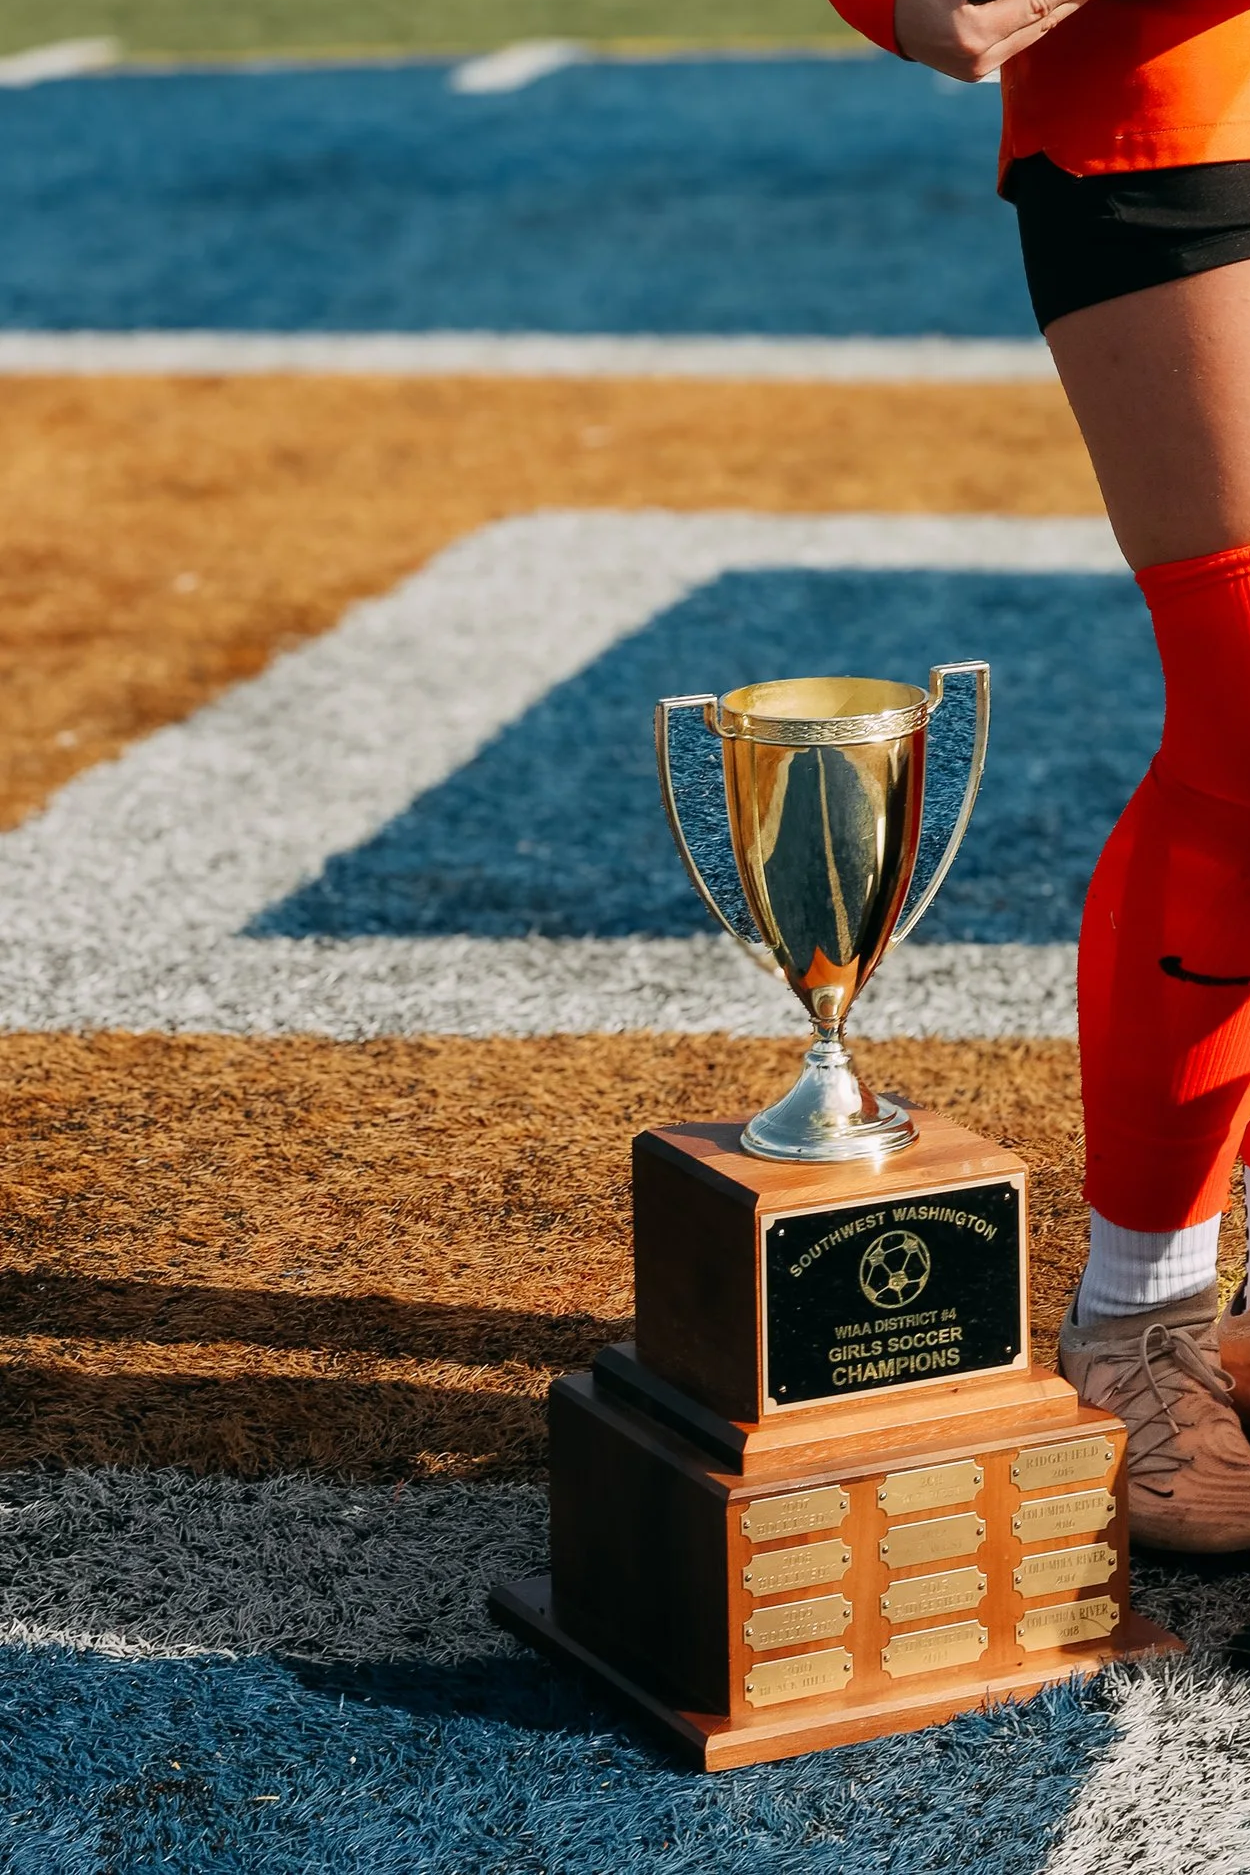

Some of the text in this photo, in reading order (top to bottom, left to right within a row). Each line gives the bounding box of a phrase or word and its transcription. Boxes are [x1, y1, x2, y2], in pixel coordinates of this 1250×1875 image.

[789, 1205, 999, 1278] SOUTHWEST WASHINGTON
[834, 1306, 958, 1341] WIAA DISTRICT #4
[828, 1326, 964, 1363] GIRLS SOCCER
[831, 1347, 961, 1387] CHAMPIONS
[1026, 1444, 1100, 1469] RIDGEFIELD
[1076, 1548, 1108, 1565] RIVER
[1079, 1602, 1109, 1619] RIVER
[1057, 1624, 1080, 1639] 2018
